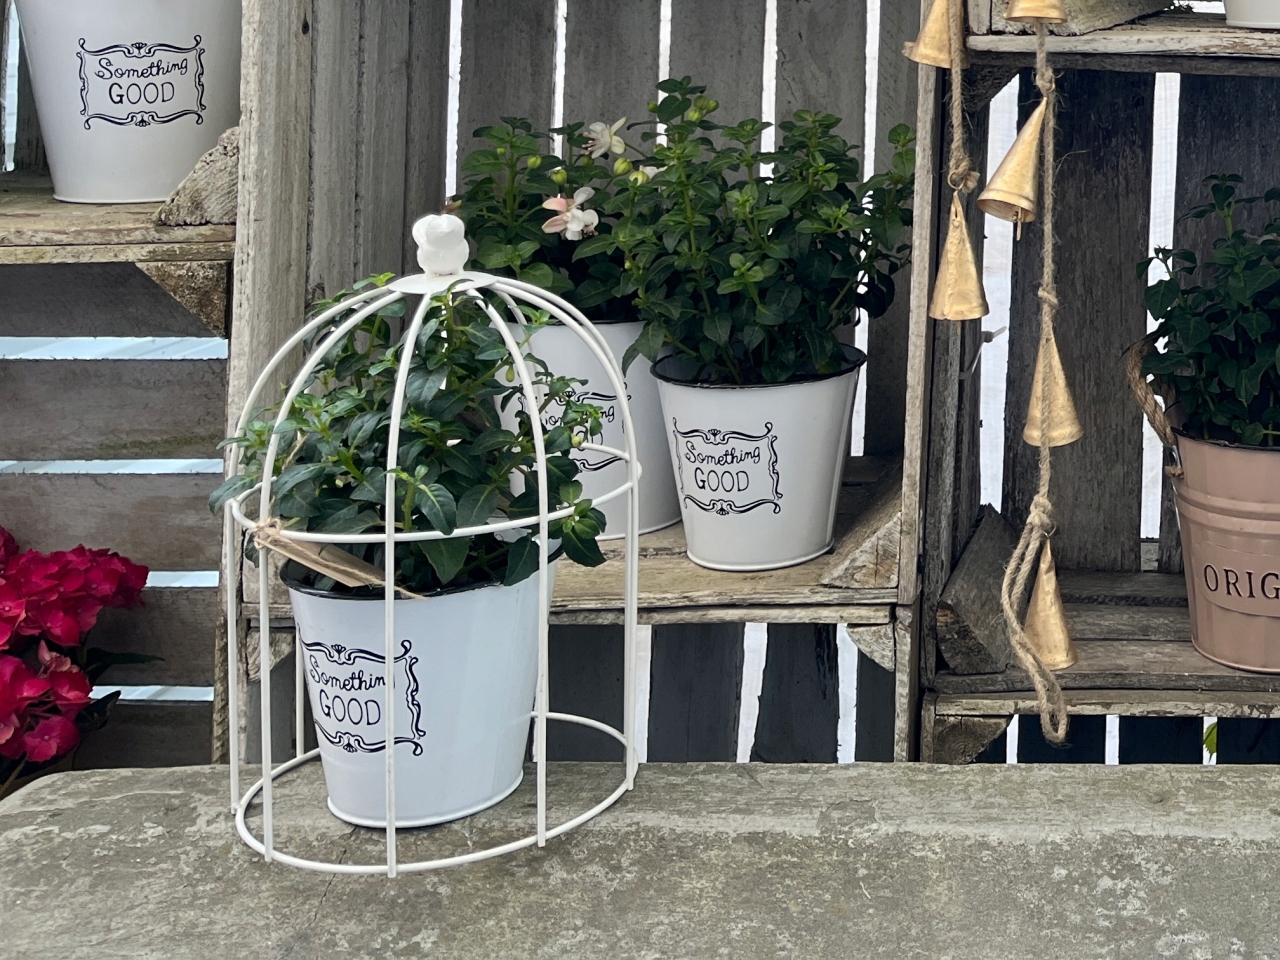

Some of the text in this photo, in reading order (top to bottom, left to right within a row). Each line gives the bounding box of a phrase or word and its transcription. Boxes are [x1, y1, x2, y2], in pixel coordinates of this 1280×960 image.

[94, 57, 188, 79] Something
[108, 82, 175, 104] GOOD
[684, 440, 760, 466] Something
[694, 467, 749, 492] GOOD
[309, 654, 396, 691] Somethin
[319, 689, 381, 726] GOOD
